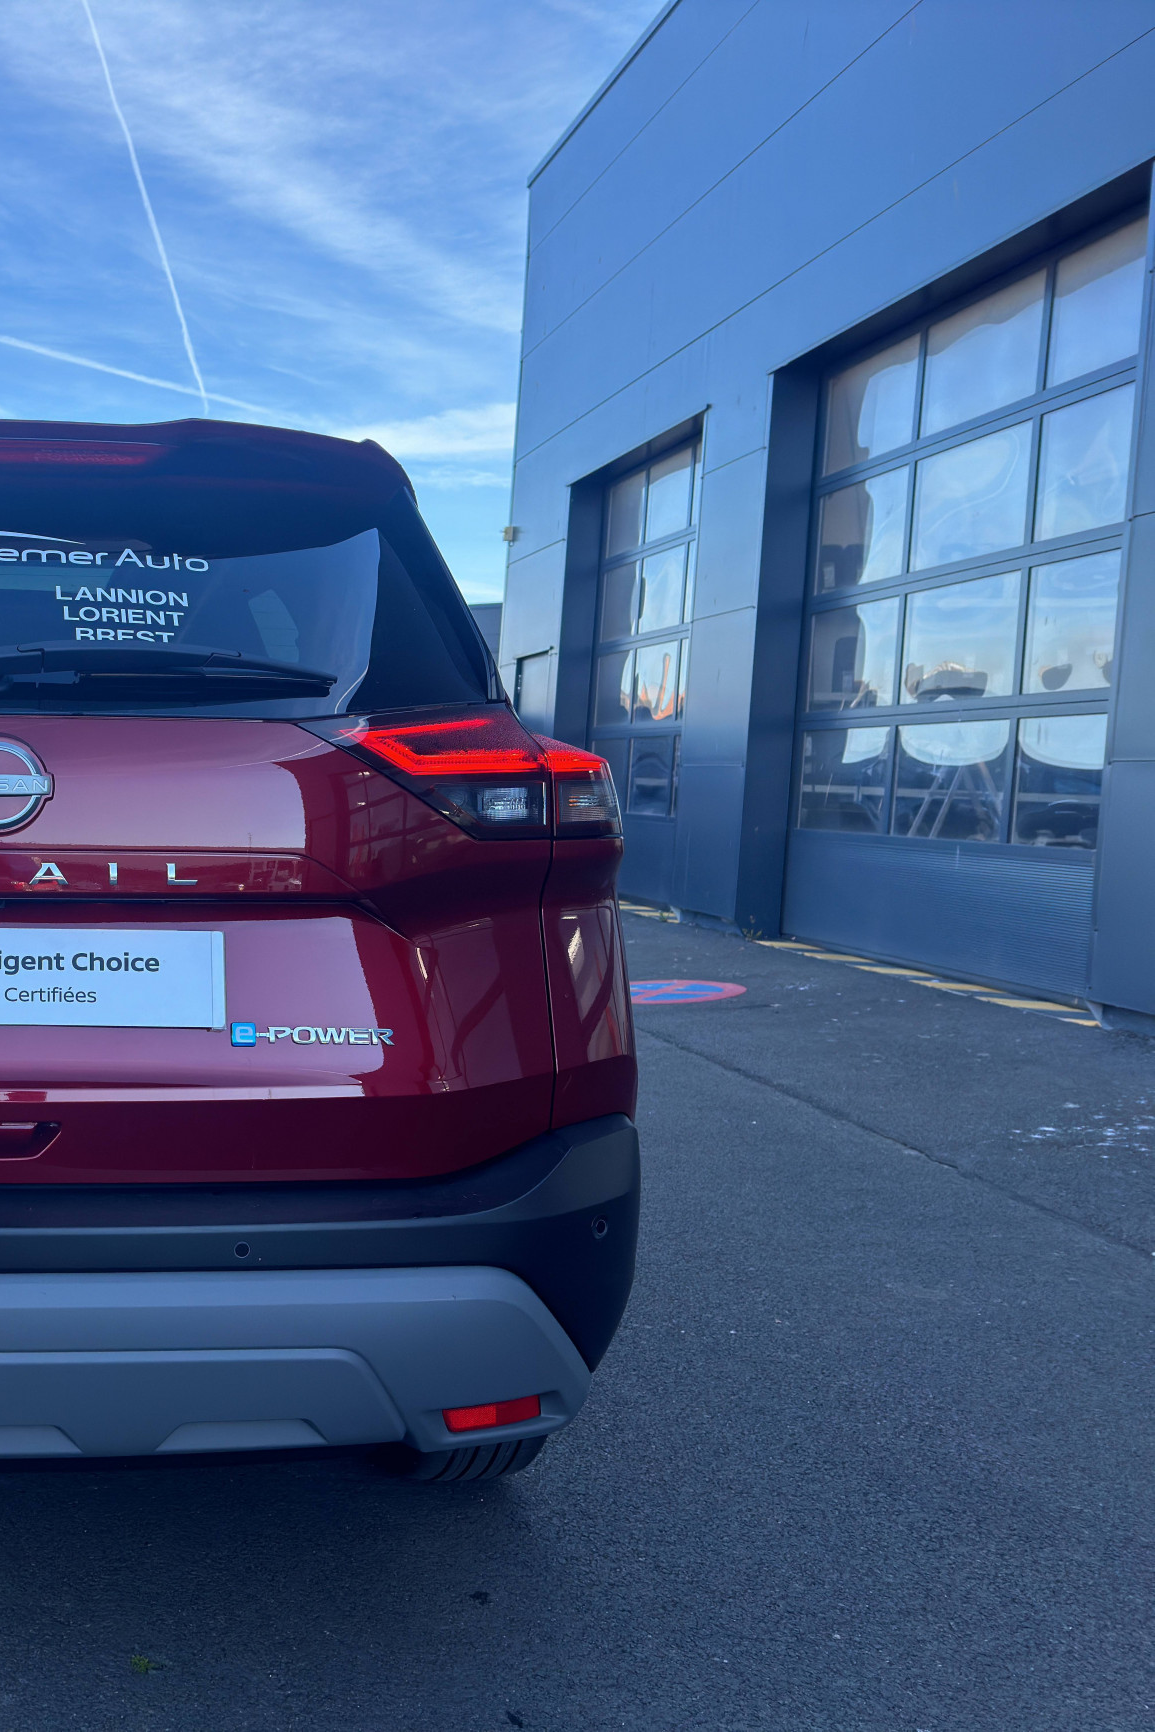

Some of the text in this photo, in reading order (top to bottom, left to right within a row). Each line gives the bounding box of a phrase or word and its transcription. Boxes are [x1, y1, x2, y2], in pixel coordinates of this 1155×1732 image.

[114, 548, 209, 573] Auto
[55, 585, 189, 607] LANNION
[63, 605, 185, 627] LORIENT
[75, 627, 175, 642] BREST
[71, 952, 160, 973] Choice
[4, 985, 97, 1004] Certifiées
[231, 1022, 395, 1047] e-POWER
